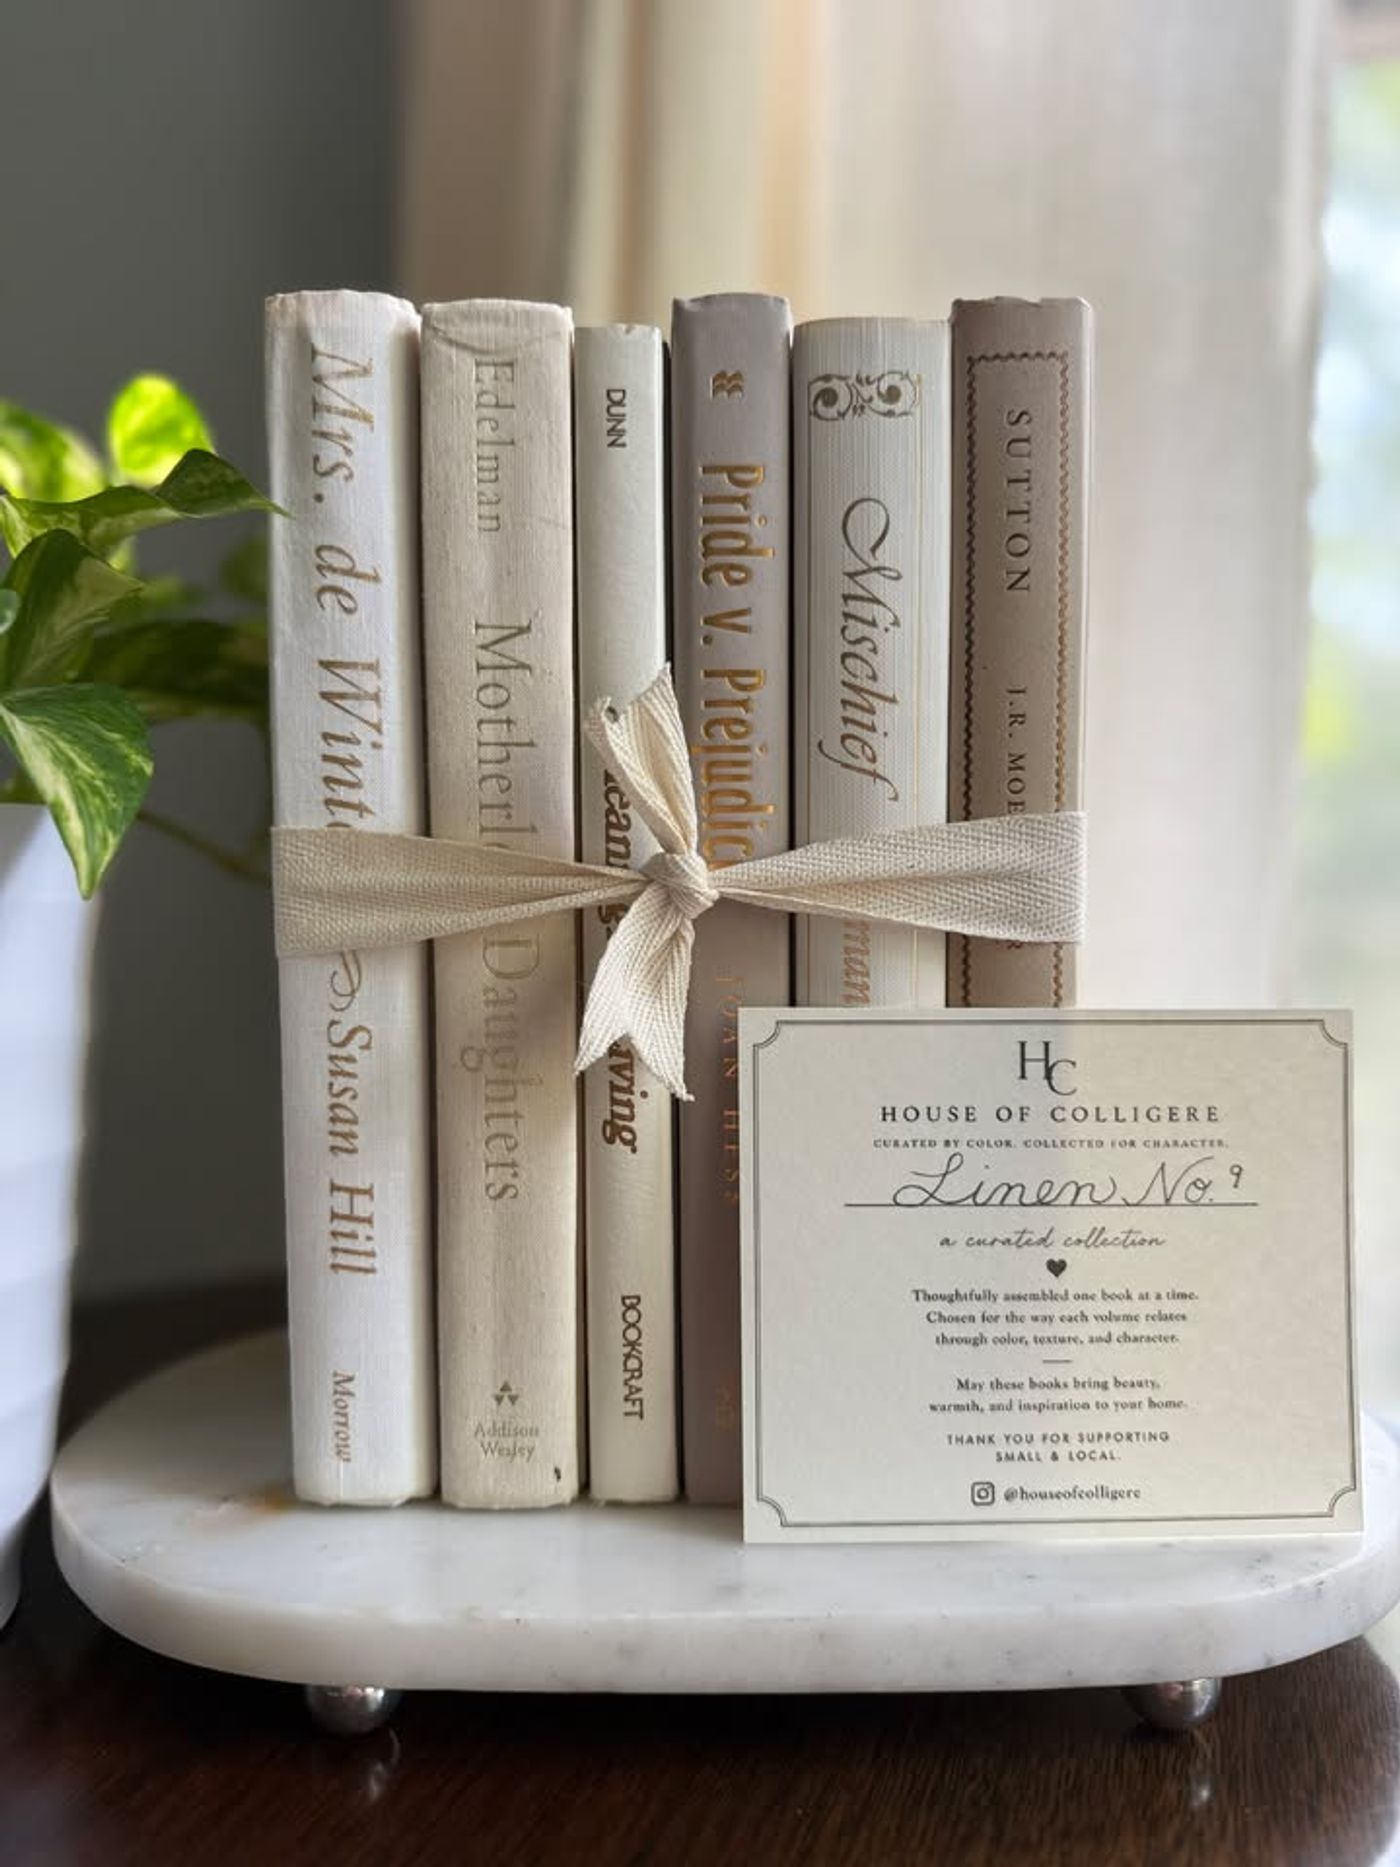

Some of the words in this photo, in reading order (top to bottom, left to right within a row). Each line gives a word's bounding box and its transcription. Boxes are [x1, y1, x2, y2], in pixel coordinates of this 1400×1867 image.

[312, 349, 373, 504] Mrs.
[475, 358, 514, 533] Edelman
[605, 388, 627, 448] DUNN
[701, 465, 776, 587] Pride
[1003, 410, 1033, 592] SUTTON
[316, 544, 383, 616] de
[701, 608, 752, 646] v.
[818, 498, 903, 800] Mischief
[316, 658, 384, 828] Wint
[475, 619, 538, 849] Motherl
[691, 669, 776, 871] Prejudic
[326, 1018, 373, 1156] Susan
[460, 934, 544, 1201] Daughters
[602, 1040, 649, 1154] iving
[873, 1139, 938, 1149] CURATED
[943, 1139, 961, 1149] BY
[1023, 1138, 1105, 1149] COLLECTED
[1110, 1138, 1137, 1149] FOR
[1143, 1138, 1230, 1149] CHARACTER.
[880, 1105, 978, 1123] HOUSE
[995, 1105, 1031, 1123] OF
[1050, 1105, 1220, 1123] COLLIGERE
[892, 1152, 1117, 1207] Linen
[1122, 1155, 1215, 1206] No.
[1229, 1164, 1243, 1189] 9
[329, 1178, 377, 1275] Hill
[939, 1235, 957, 1248] a
[964, 1226, 1055, 1248] curated
[1062, 1226, 1166, 1248] collection
[911, 1288, 998, 1306] Thoughtfully
[1003, 1288, 1069, 1301] assembled
[1073, 1292, 1097, 1301] one
[1101, 1288, 1132, 1301] book
[1138, 1291, 1149, 1301] at
[1154, 1292, 1162, 1301] a
[1166, 1289, 1199, 1301] time.
[926, 1311, 976, 1323] Chosen
[981, 1310, 1000, 1323] for
[1005, 1310, 1026, 1323] the
[1030, 1314, 1055, 1326] way
[1059, 1310, 1089, 1323] each
[1093, 1310, 1140, 1322] volume
[1144, 1309, 1187, 1321] relates
[621, 1294, 644, 1420] BOOKCRAFT
[935, 1332, 988, 1347] through
[992, 1332, 1028, 1346] color,
[1033, 1334, 1084, 1345] texture,
[1088, 1331, 1112, 1344] and
[1116, 1331, 1179, 1343] character.
[929, 1400, 984, 1413] warmth,
[989, 1398, 1013, 1411] and
[1018, 1398, 1090, 1414] inspiration
[1095, 1400, 1109, 1410] to
[1113, 1399, 1142, 1412] your
[1147, 1397, 1188, 1409] home.
[956, 1378, 985, 1391] May
[989, 1378, 1024, 1390] these
[1028, 1377, 1069, 1390] books
[1073, 1376, 1109, 1391] bring
[333, 1370, 356, 1464] Morrow
[474, 1420, 539, 1438] Addison
[947, 1434, 996, 1445] THANK
[1003, 1433, 1034, 1444] YOU
[1042, 1432, 1069, 1444] FOR
[1078, 1431, 1169, 1444] SUPPORTING
[995, 1451, 1042, 1463] SMALL
[1050, 1450, 1059, 1462] &
[1068, 1449, 1121, 1462] LOCAL.
[1003, 1484, 1141, 1502] @houseofcolligere
